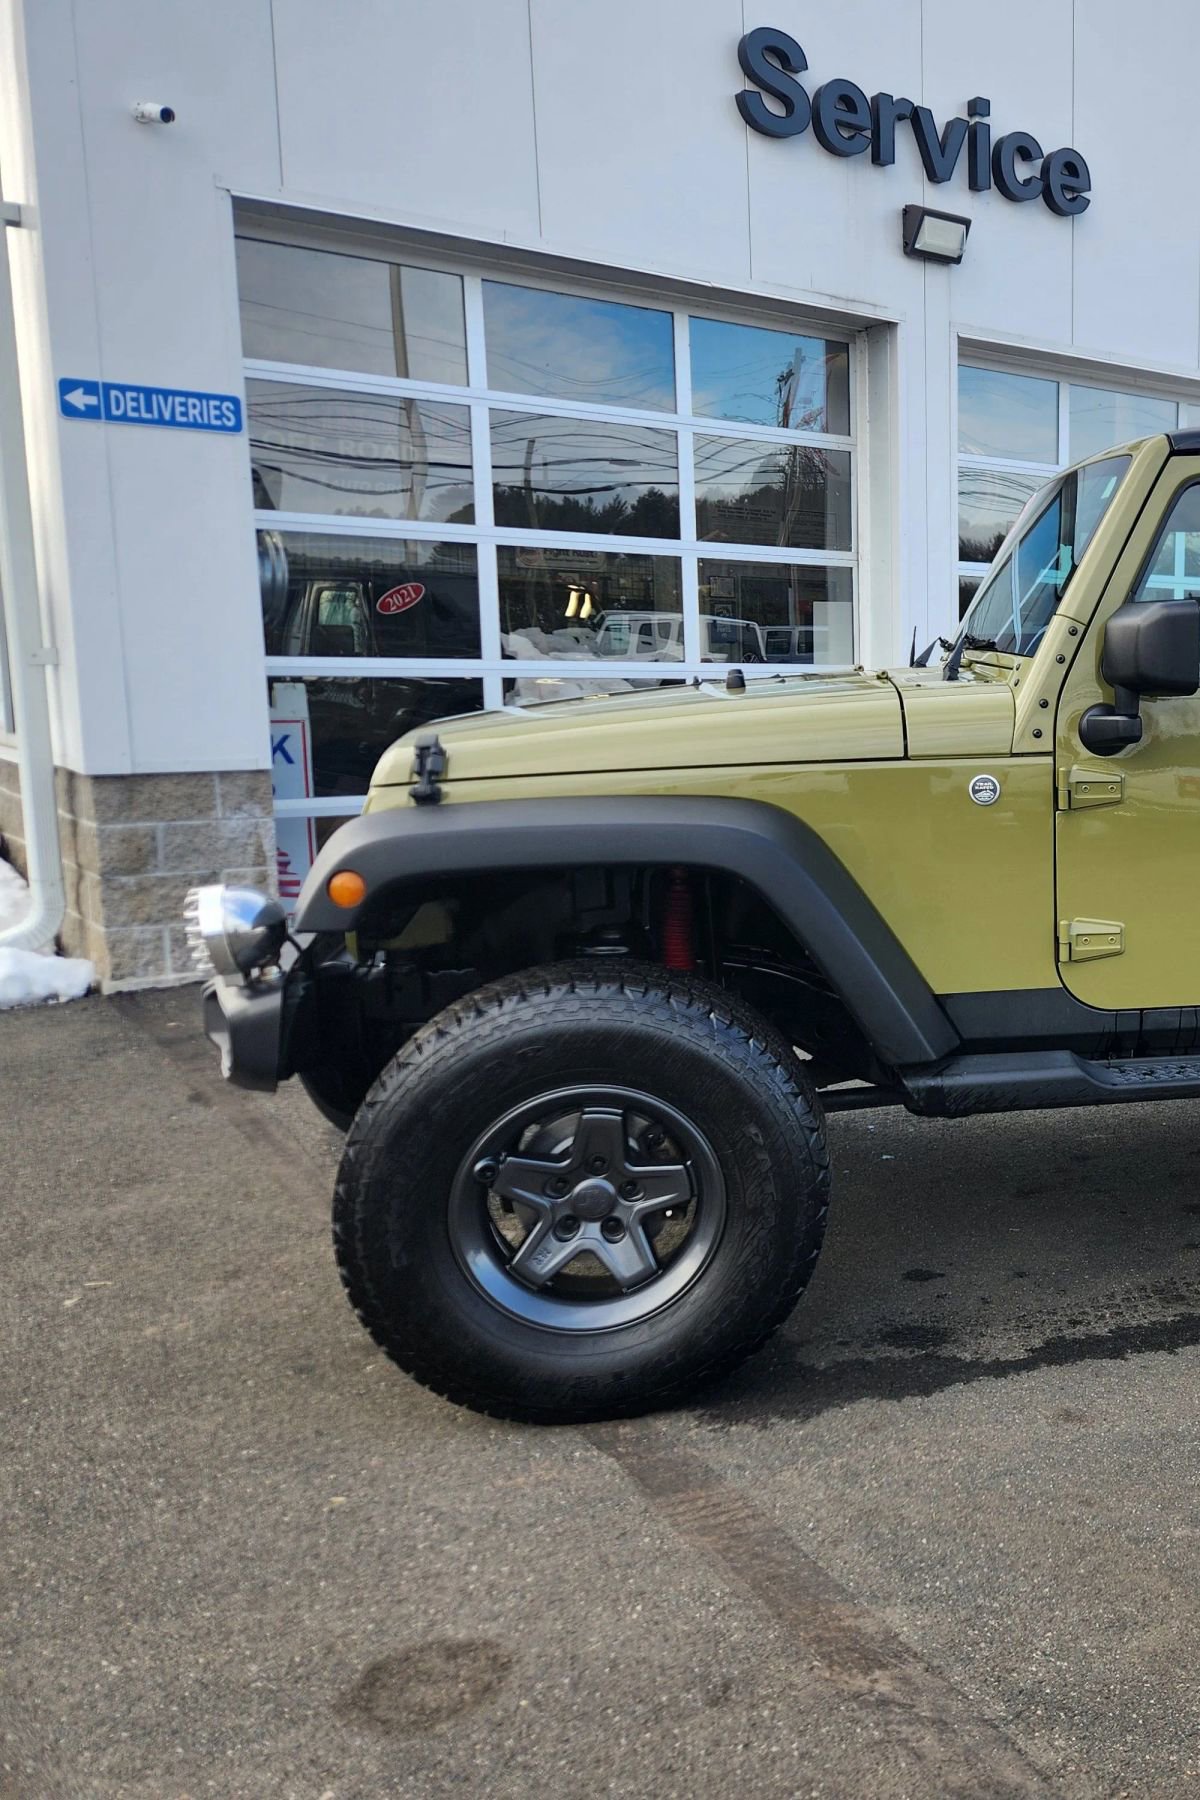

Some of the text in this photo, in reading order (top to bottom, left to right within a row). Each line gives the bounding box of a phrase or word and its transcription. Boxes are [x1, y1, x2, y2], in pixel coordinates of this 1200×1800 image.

[735, 27, 1092, 217] Service
[109, 389, 236, 427] DELIVERIES
[384, 585, 417, 612] 2021
